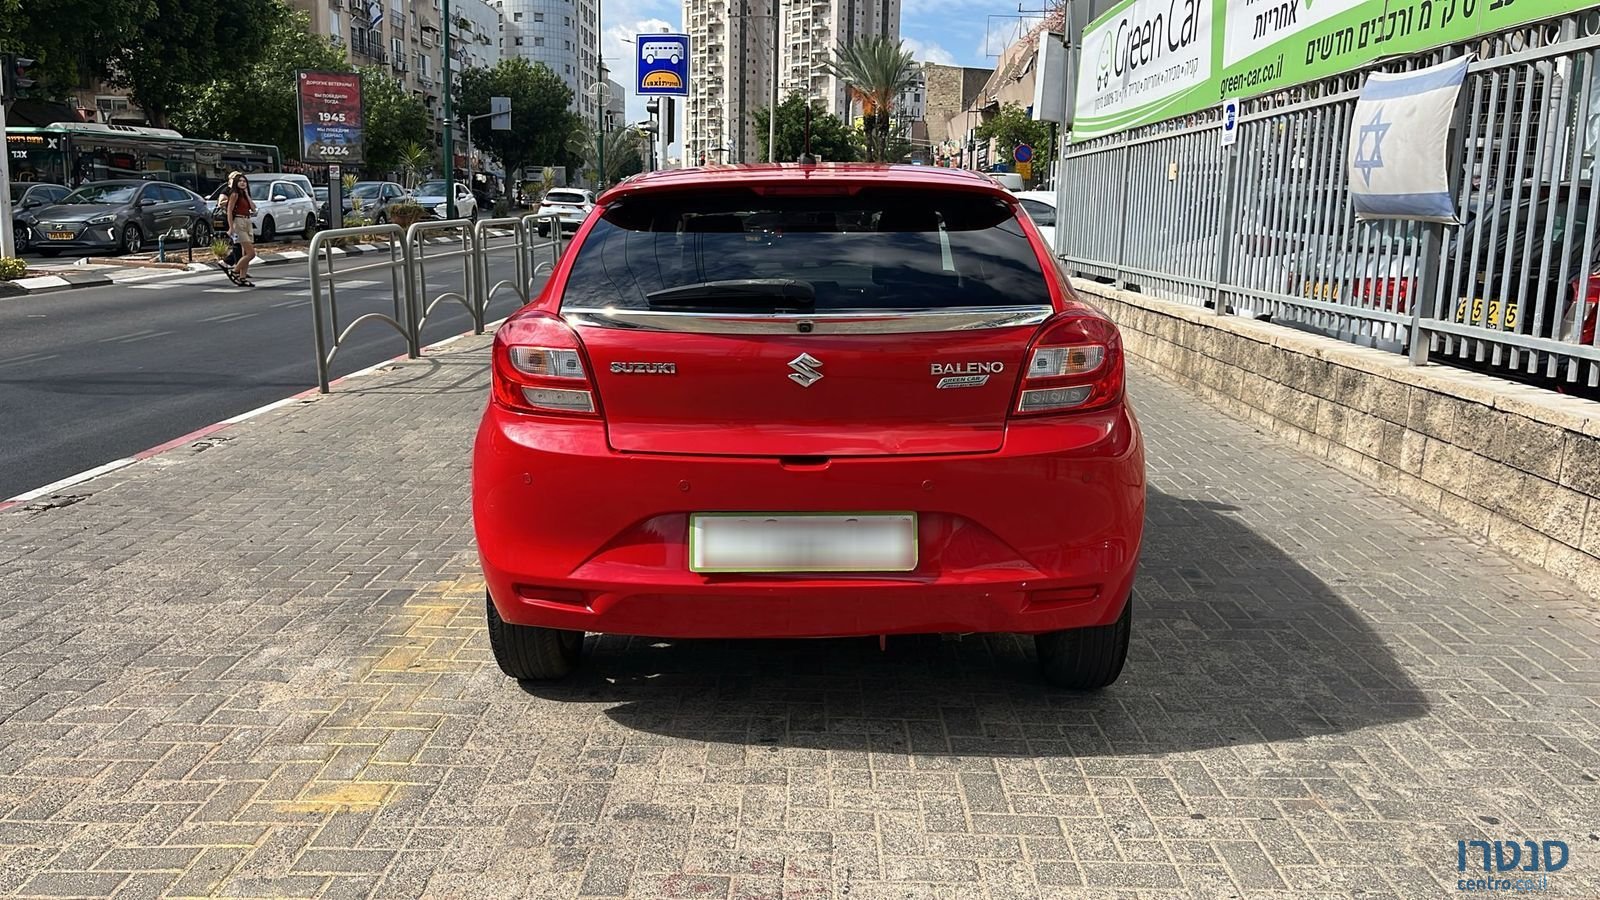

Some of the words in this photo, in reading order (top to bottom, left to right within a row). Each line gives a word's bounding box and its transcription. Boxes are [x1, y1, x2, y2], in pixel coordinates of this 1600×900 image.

[1253, 0, 1298, 40] אחריות
[1358, 6, 1413, 49] ורכבים
[1114, 13, 1163, 77] Green
[1305, 26, 1353, 65] חדשים
[1220, 53, 1284, 99] green-car.co.il
[318, 112, 346, 122] 1945
[320, 146, 349, 155] 2024
[610, 362, 676, 374] SUZUKI
[930, 361, 1004, 375] BALENO
